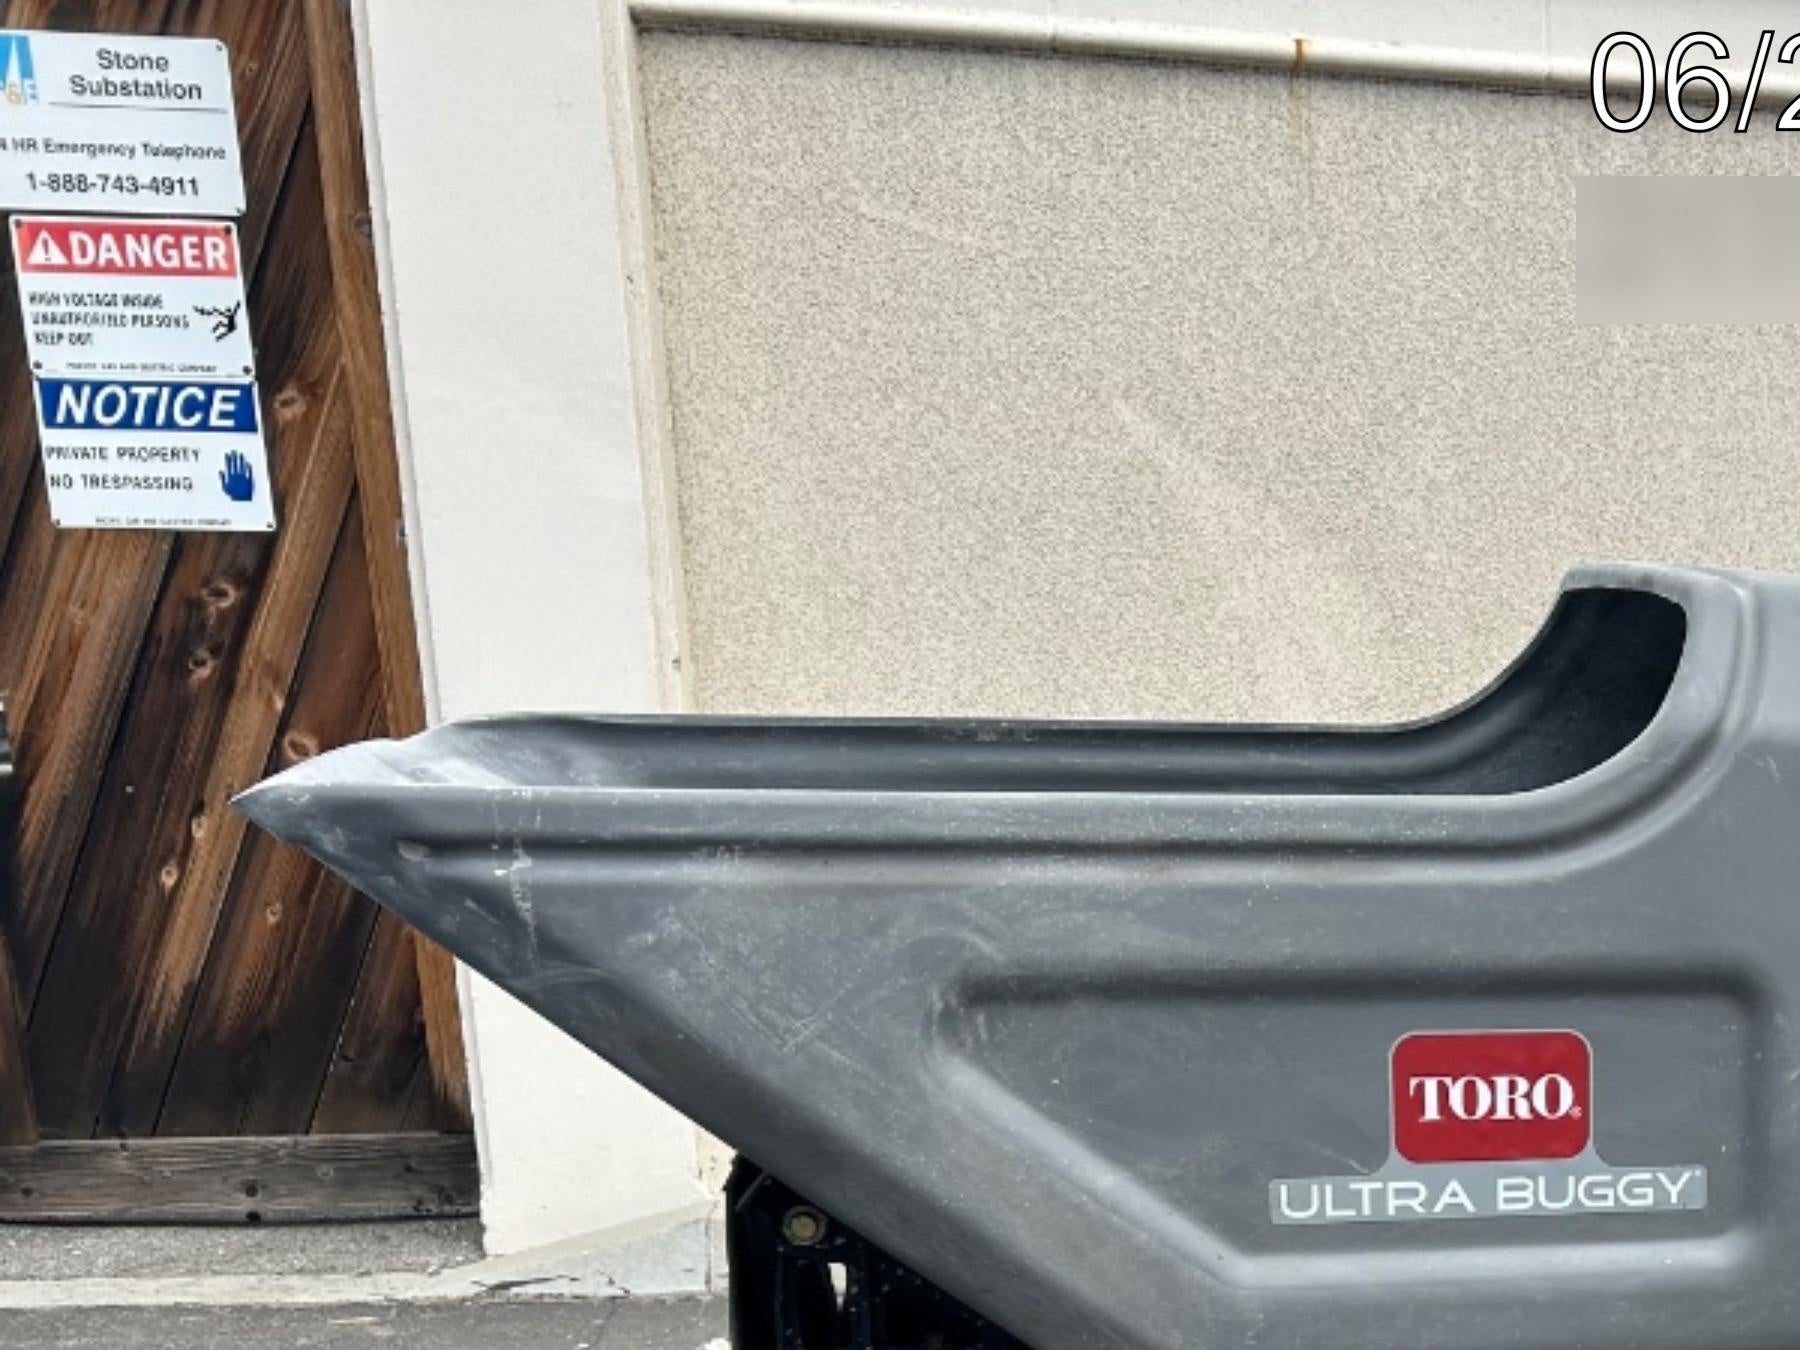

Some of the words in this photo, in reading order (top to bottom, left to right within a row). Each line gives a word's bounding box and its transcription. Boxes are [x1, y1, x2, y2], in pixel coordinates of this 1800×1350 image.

[96, 48, 169, 72] Stone
[69, 75, 203, 100] Substation
[11, 137, 39, 152] HR
[43, 138, 136, 160] Emergency
[26, 172, 199, 196] 1-888-743-4911
[68, 230, 229, 271] DANGER
[56, 383, 241, 428] NOTICE
[47, 446, 109, 462] PRIVATE
[117, 447, 202, 463] PROPERTY
[50, 475, 73, 489] NO
[81, 475, 194, 492] TRESPASSING
[1409, 1072, 1576, 1123] TORO
[1278, 1178, 1478, 1219] ULTRA
[1496, 1170, 1692, 1211] BUGGY
